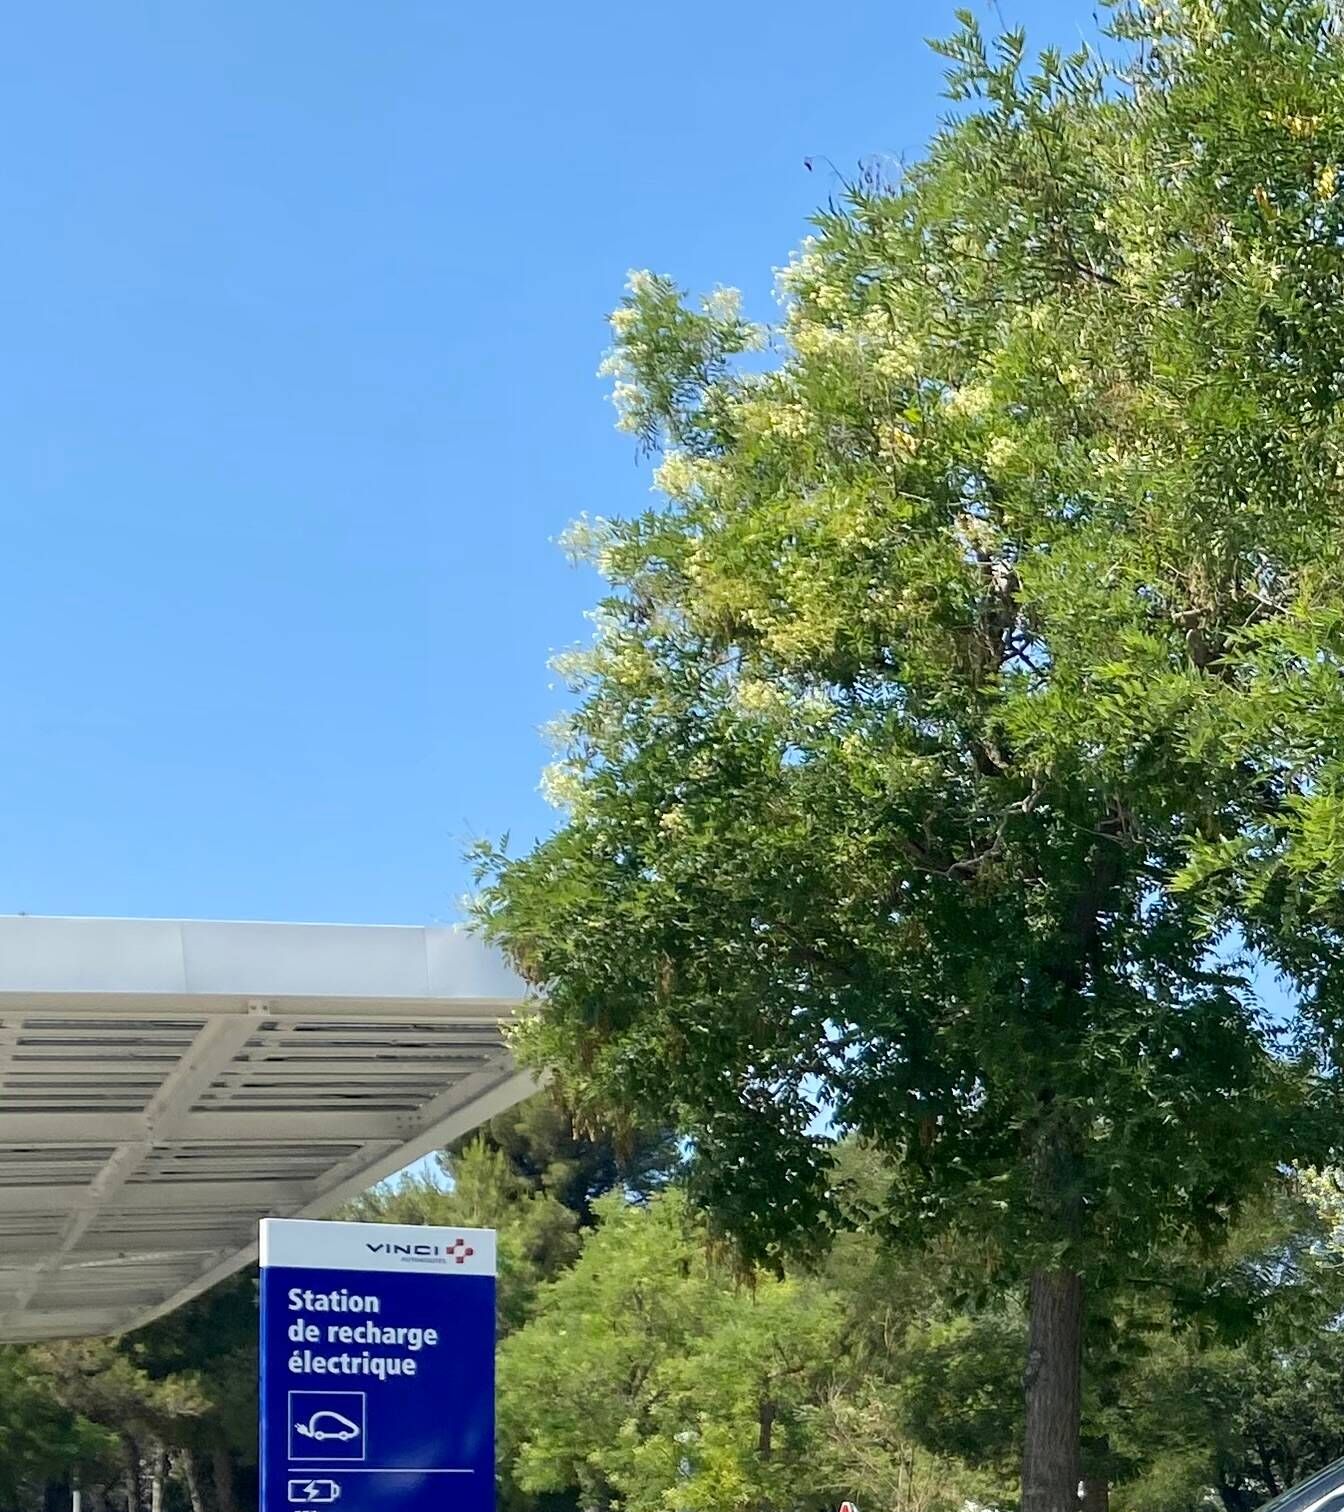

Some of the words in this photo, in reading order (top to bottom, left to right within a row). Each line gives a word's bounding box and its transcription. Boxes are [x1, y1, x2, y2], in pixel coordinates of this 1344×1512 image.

[366, 1243, 439, 1256] VINCI
[288, 1288, 379, 1313] Station
[288, 1318, 320, 1343] de
[327, 1320, 438, 1351] recharge
[288, 1350, 417, 1380] électrique
